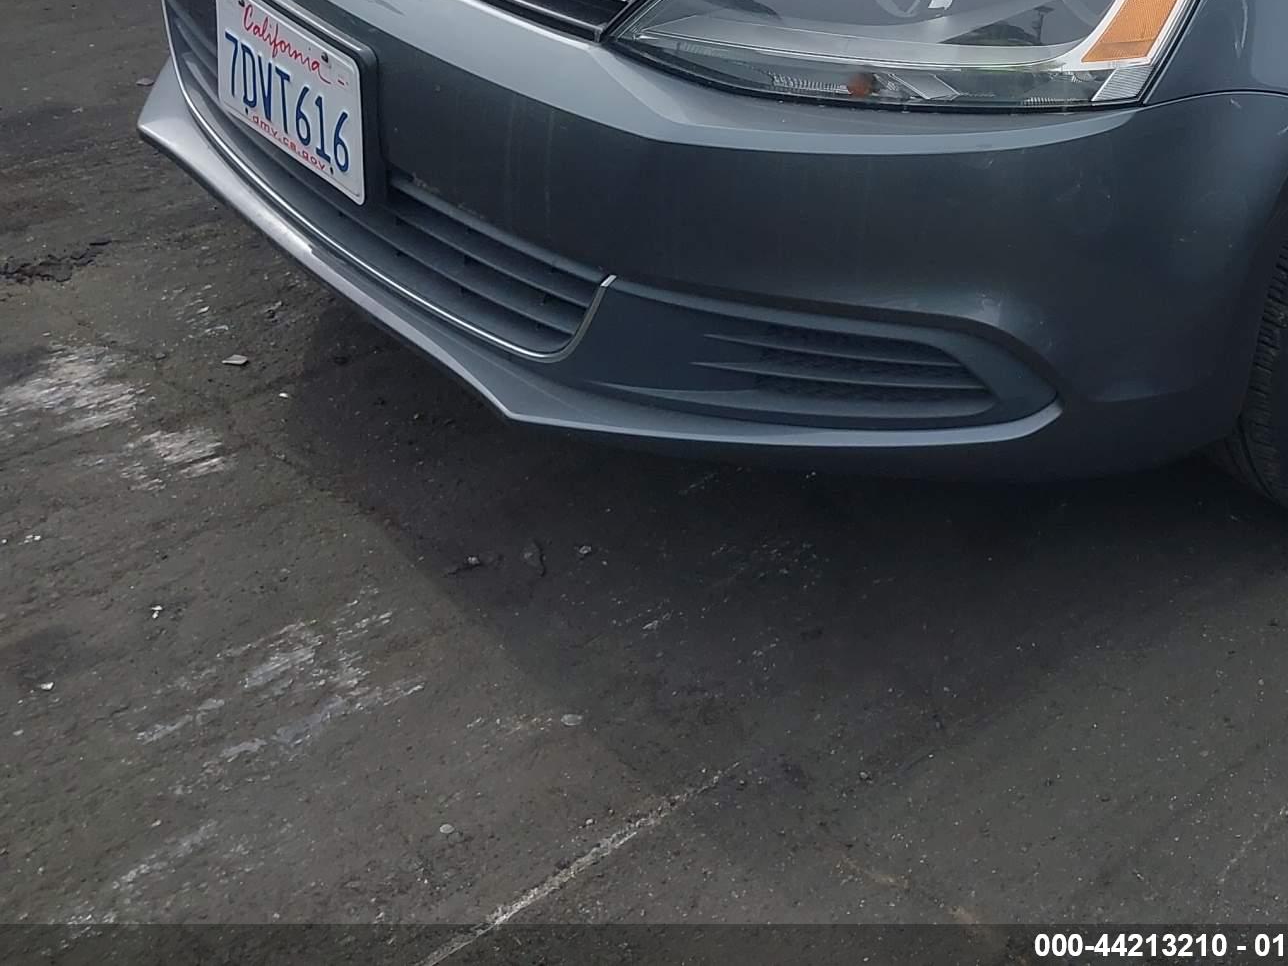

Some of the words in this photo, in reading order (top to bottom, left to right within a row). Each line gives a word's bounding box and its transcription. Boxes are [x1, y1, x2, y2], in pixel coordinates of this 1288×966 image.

[242, 2, 332, 85] California
[224, 30, 349, 172] 7DVT616
[251, 114, 326, 171] dmv.ca.gov
